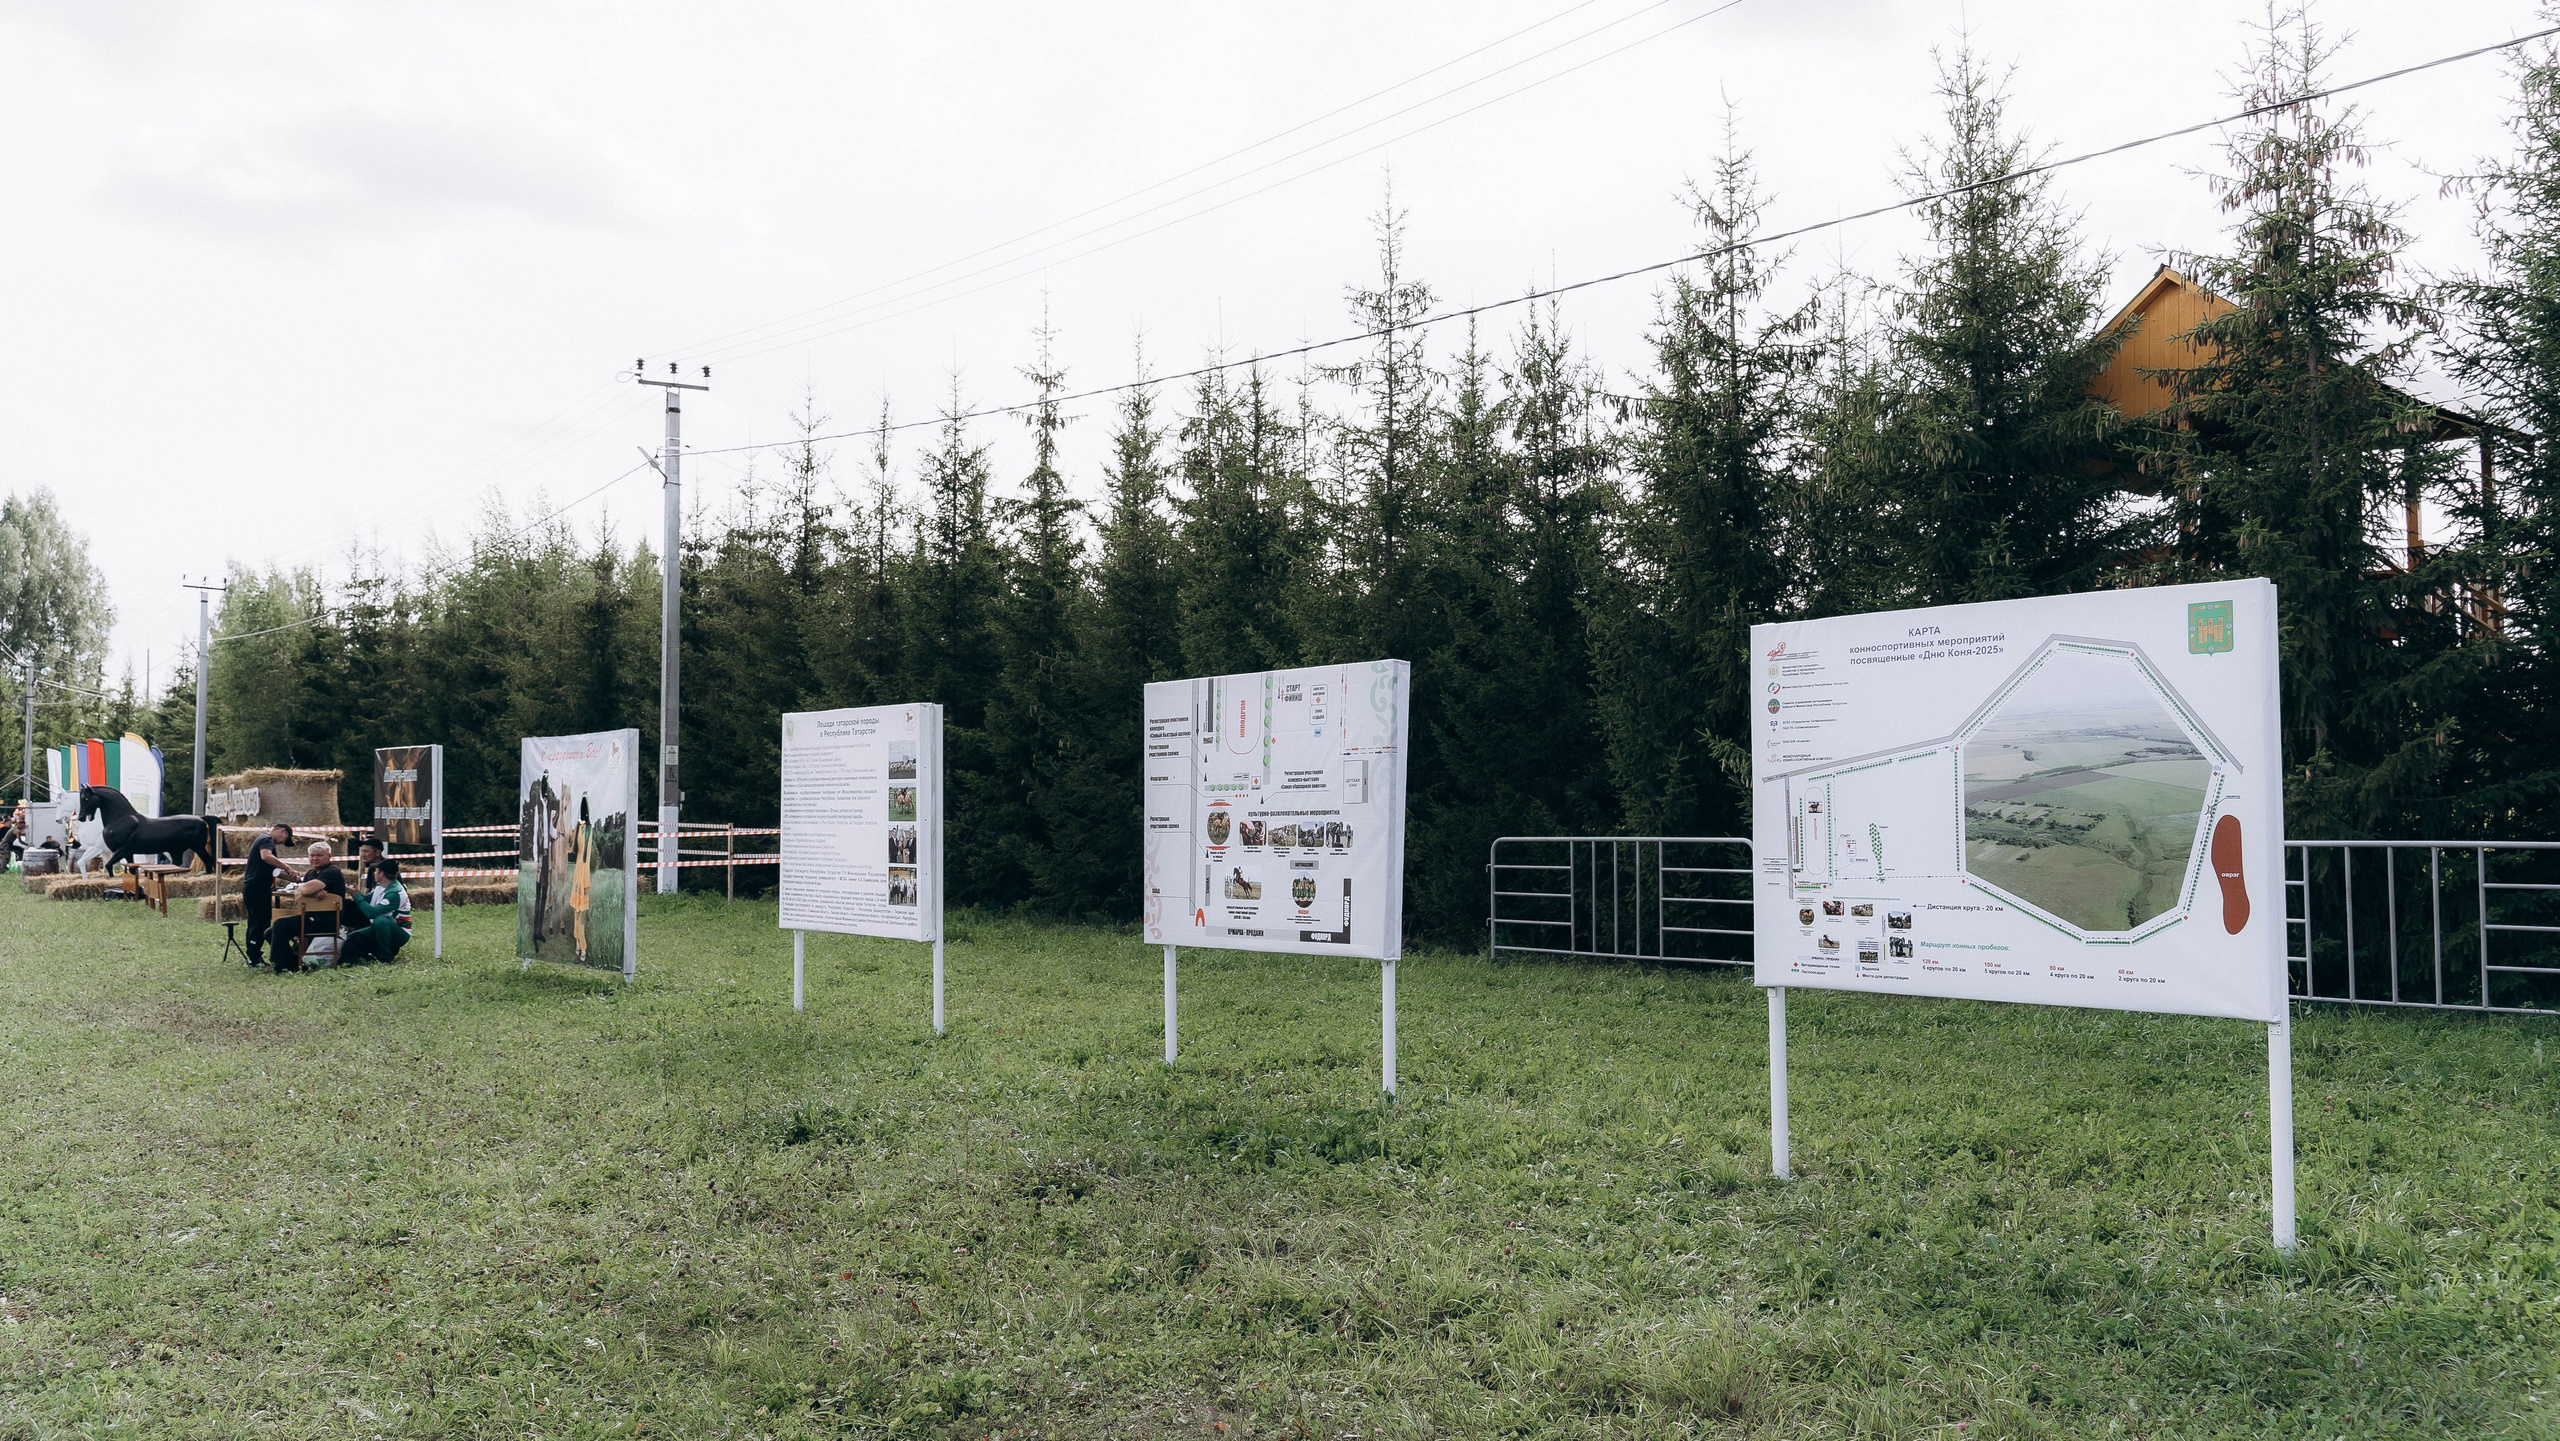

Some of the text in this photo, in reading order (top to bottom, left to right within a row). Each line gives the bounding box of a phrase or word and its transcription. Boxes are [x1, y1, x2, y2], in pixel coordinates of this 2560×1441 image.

[1908, 626, 1940, 637] КАРТА
[1850, 633, 2004, 654] конноспортивных мероприятий
[1850, 644, 2004, 665] посвященные «Дню Коня-2025»
[1286, 684, 1301, 692] СТАРТ
[836, 718, 859, 726] татарской
[824, 729, 850, 738] Республике
[1927, 904, 1961, 912] Дистанция
[1920, 941, 1951, 949] Маршрут
